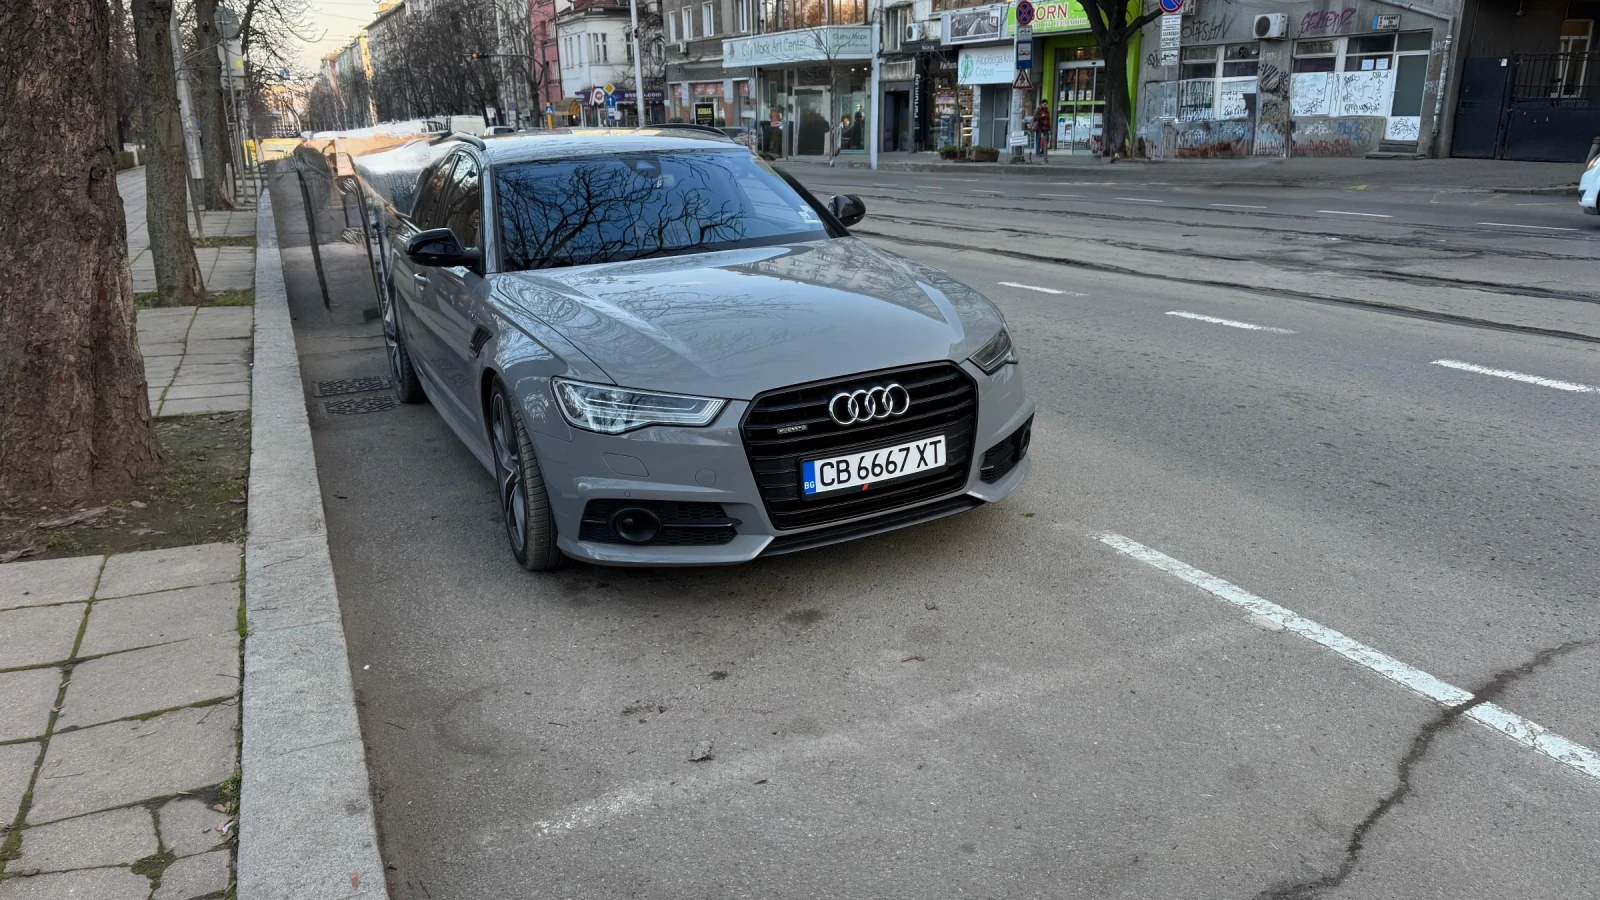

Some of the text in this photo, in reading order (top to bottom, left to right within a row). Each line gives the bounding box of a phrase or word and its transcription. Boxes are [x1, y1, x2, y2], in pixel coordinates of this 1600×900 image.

[742, 42, 753, 59] City
[772, 38, 782, 53] Art
[784, 36, 807, 52] Center
[819, 439, 942, 487] CB 6667 XT
[804, 481, 815, 490] BG
